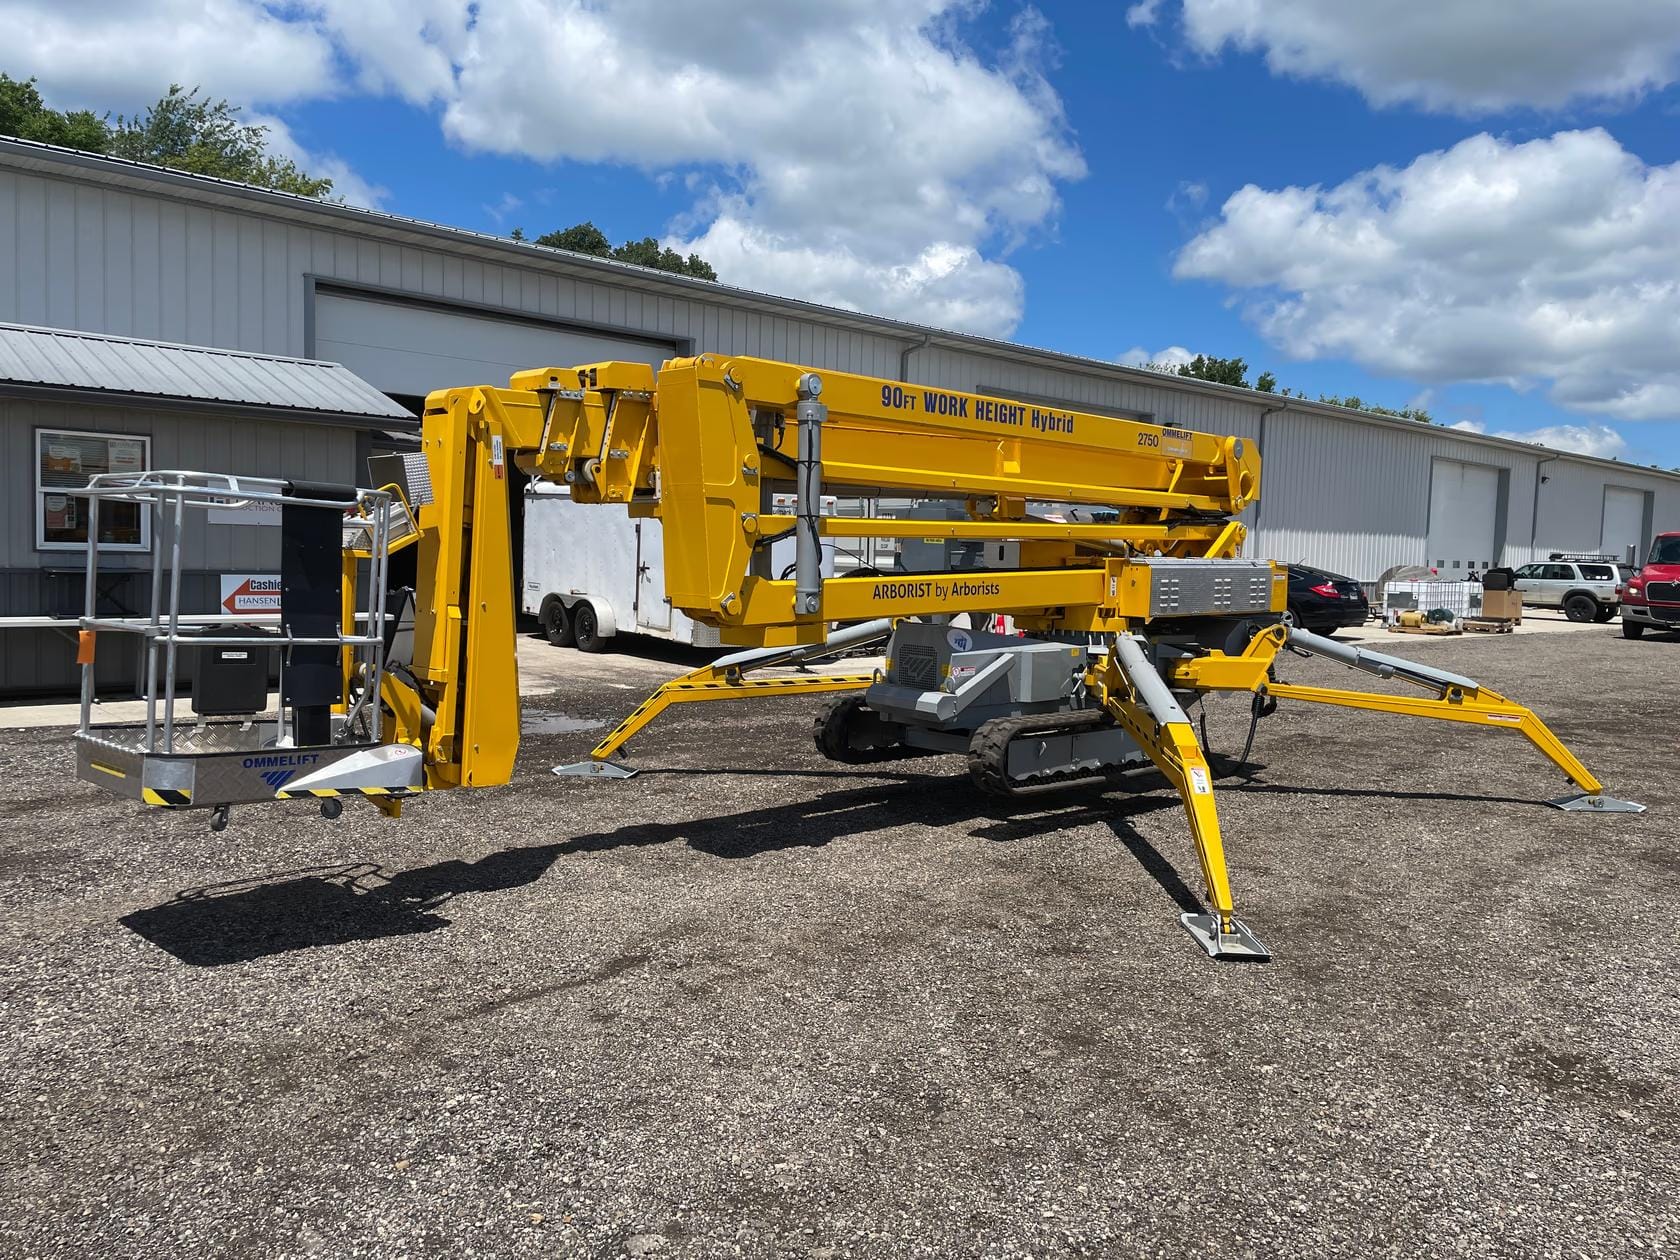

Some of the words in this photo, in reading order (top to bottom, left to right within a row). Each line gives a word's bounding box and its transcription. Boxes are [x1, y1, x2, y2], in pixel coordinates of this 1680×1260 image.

[881, 385, 917, 410] 90FT
[924, 391, 969, 418] WORK
[976, 400, 1026, 426] HEIGHT
[1032, 408, 1074, 434] Hybrid
[1137, 432, 1159, 448] 2750
[873, 583, 932, 600] ARBORIST
[935, 582, 949, 601] by
[951, 581, 1000, 597] Arborists
[242, 754, 319, 769] OMMELIFT
